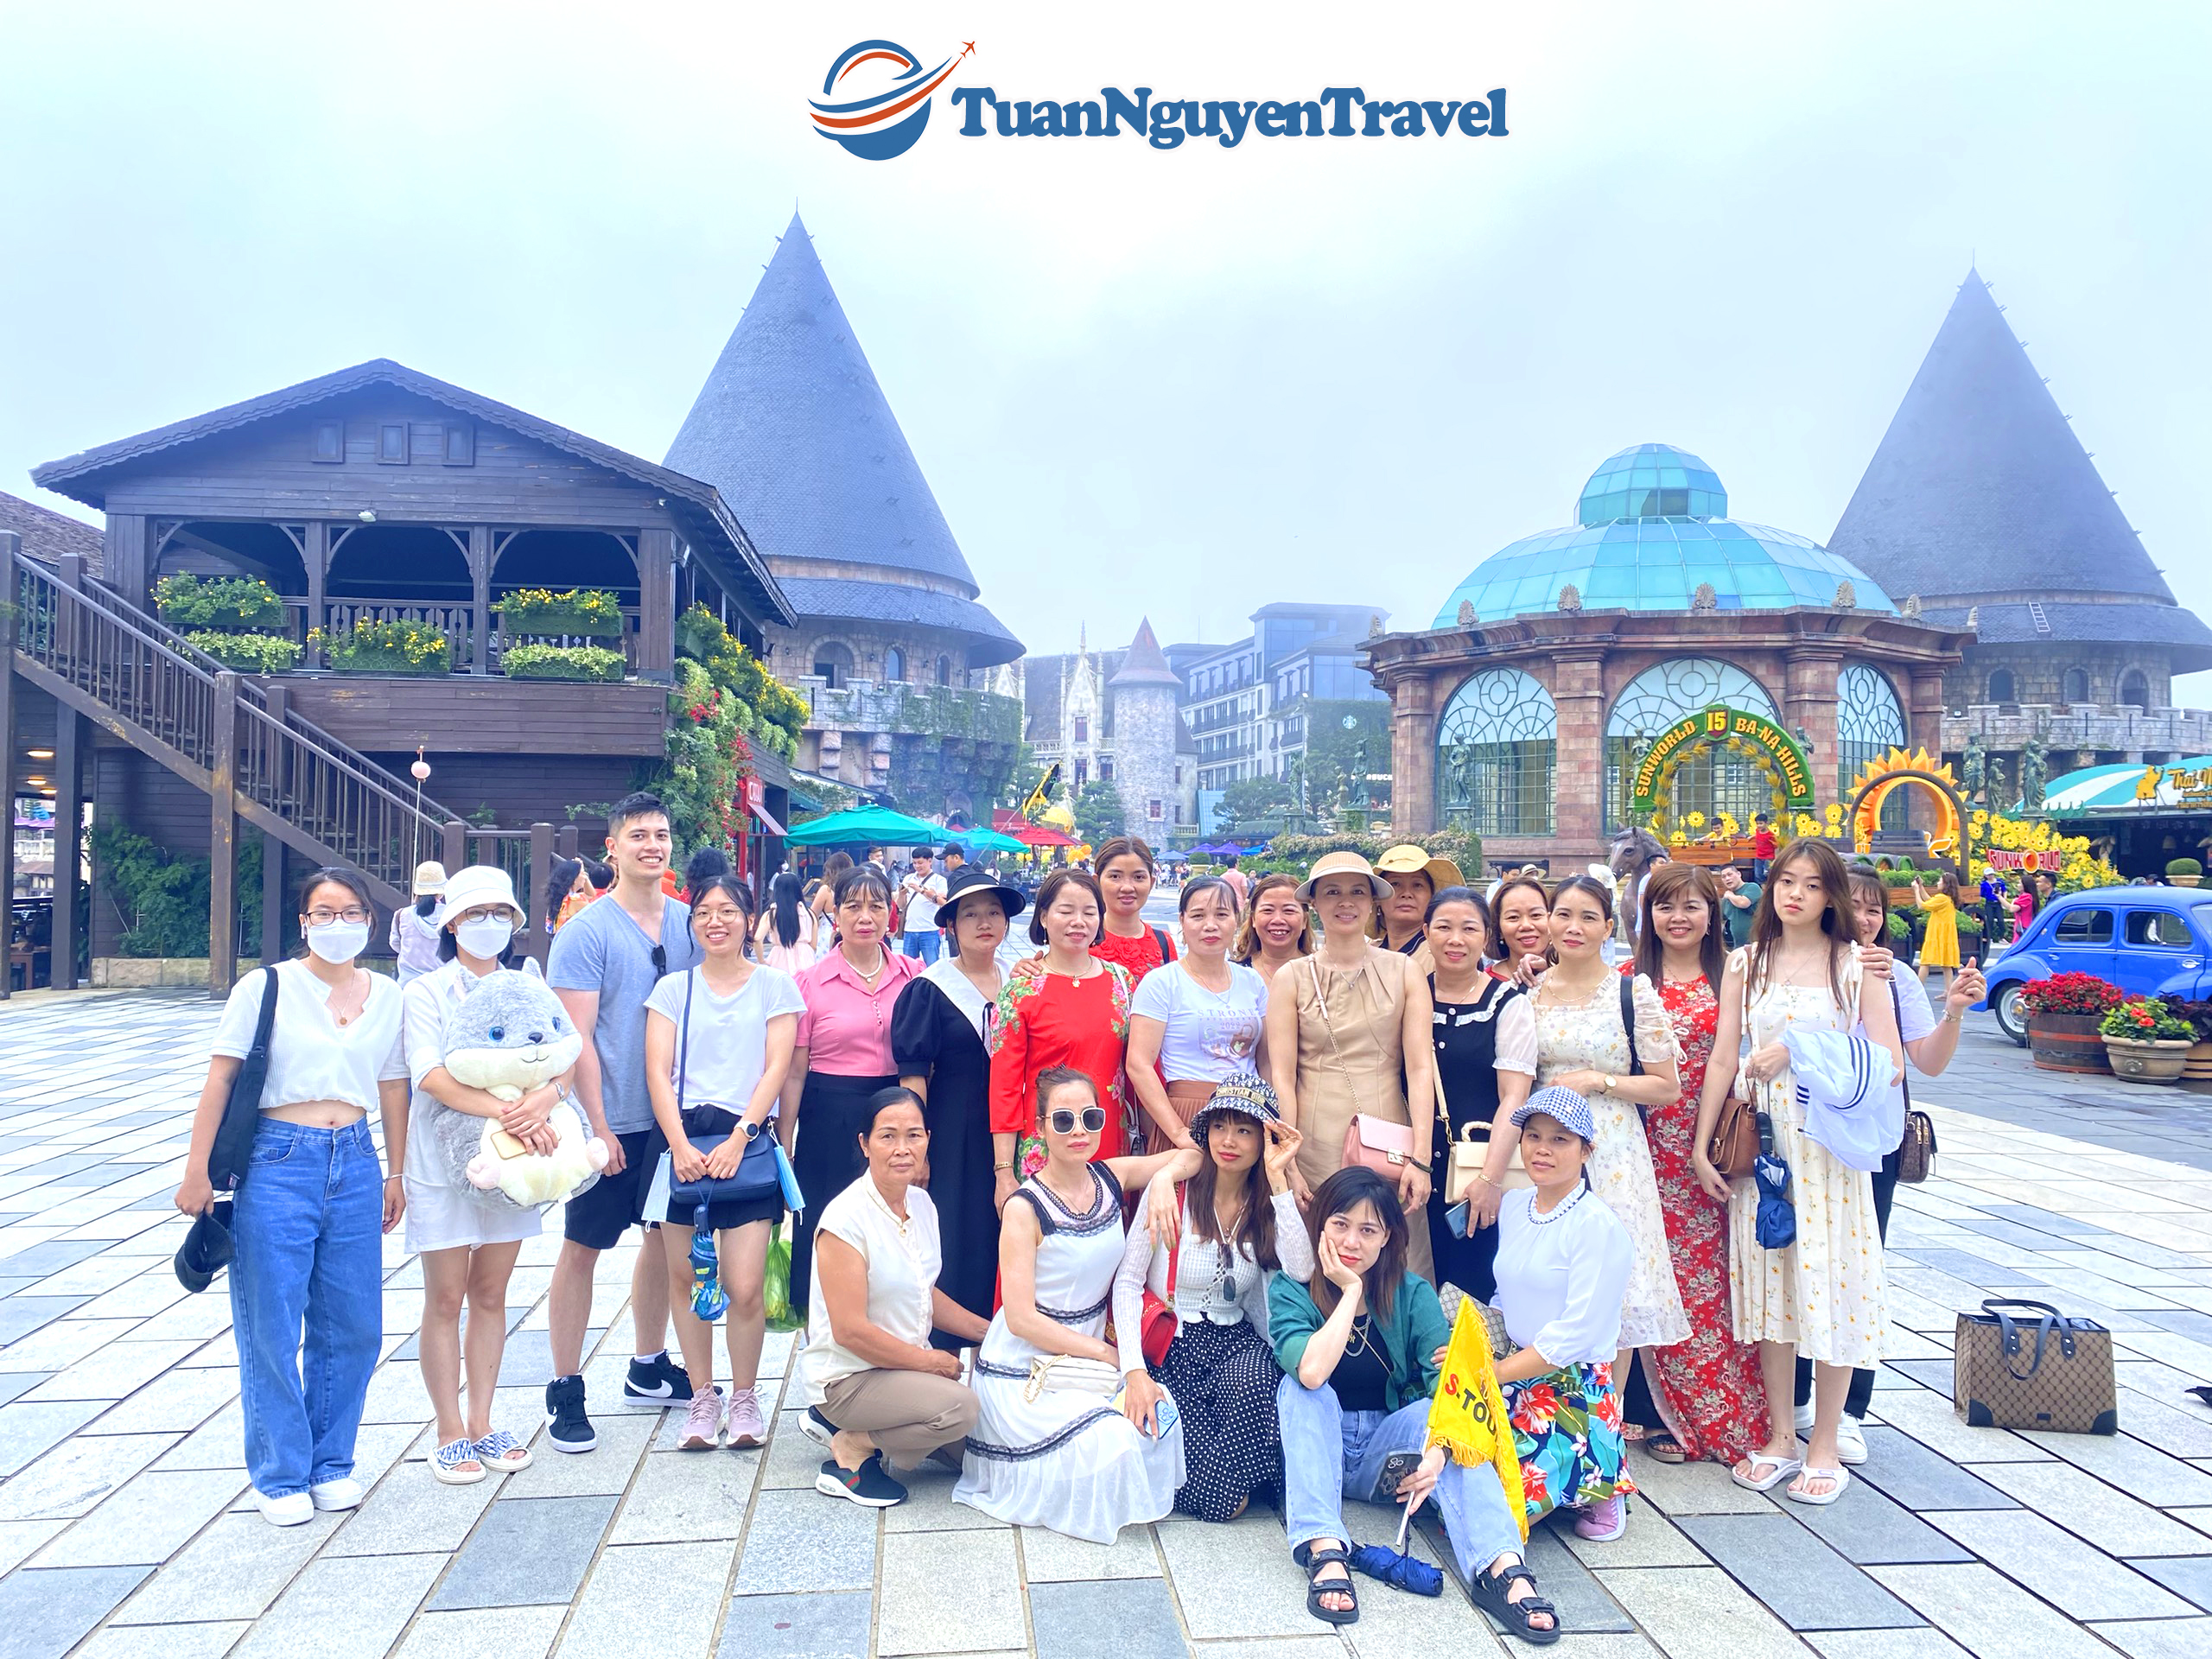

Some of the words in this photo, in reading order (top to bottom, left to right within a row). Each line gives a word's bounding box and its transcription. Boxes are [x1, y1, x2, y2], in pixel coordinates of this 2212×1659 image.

[1707, 712, 1727, 732] 15
[1735, 717, 1758, 734] BA
[1758, 726, 1781, 750] NA
[1776, 746, 1807, 797] HILLS
